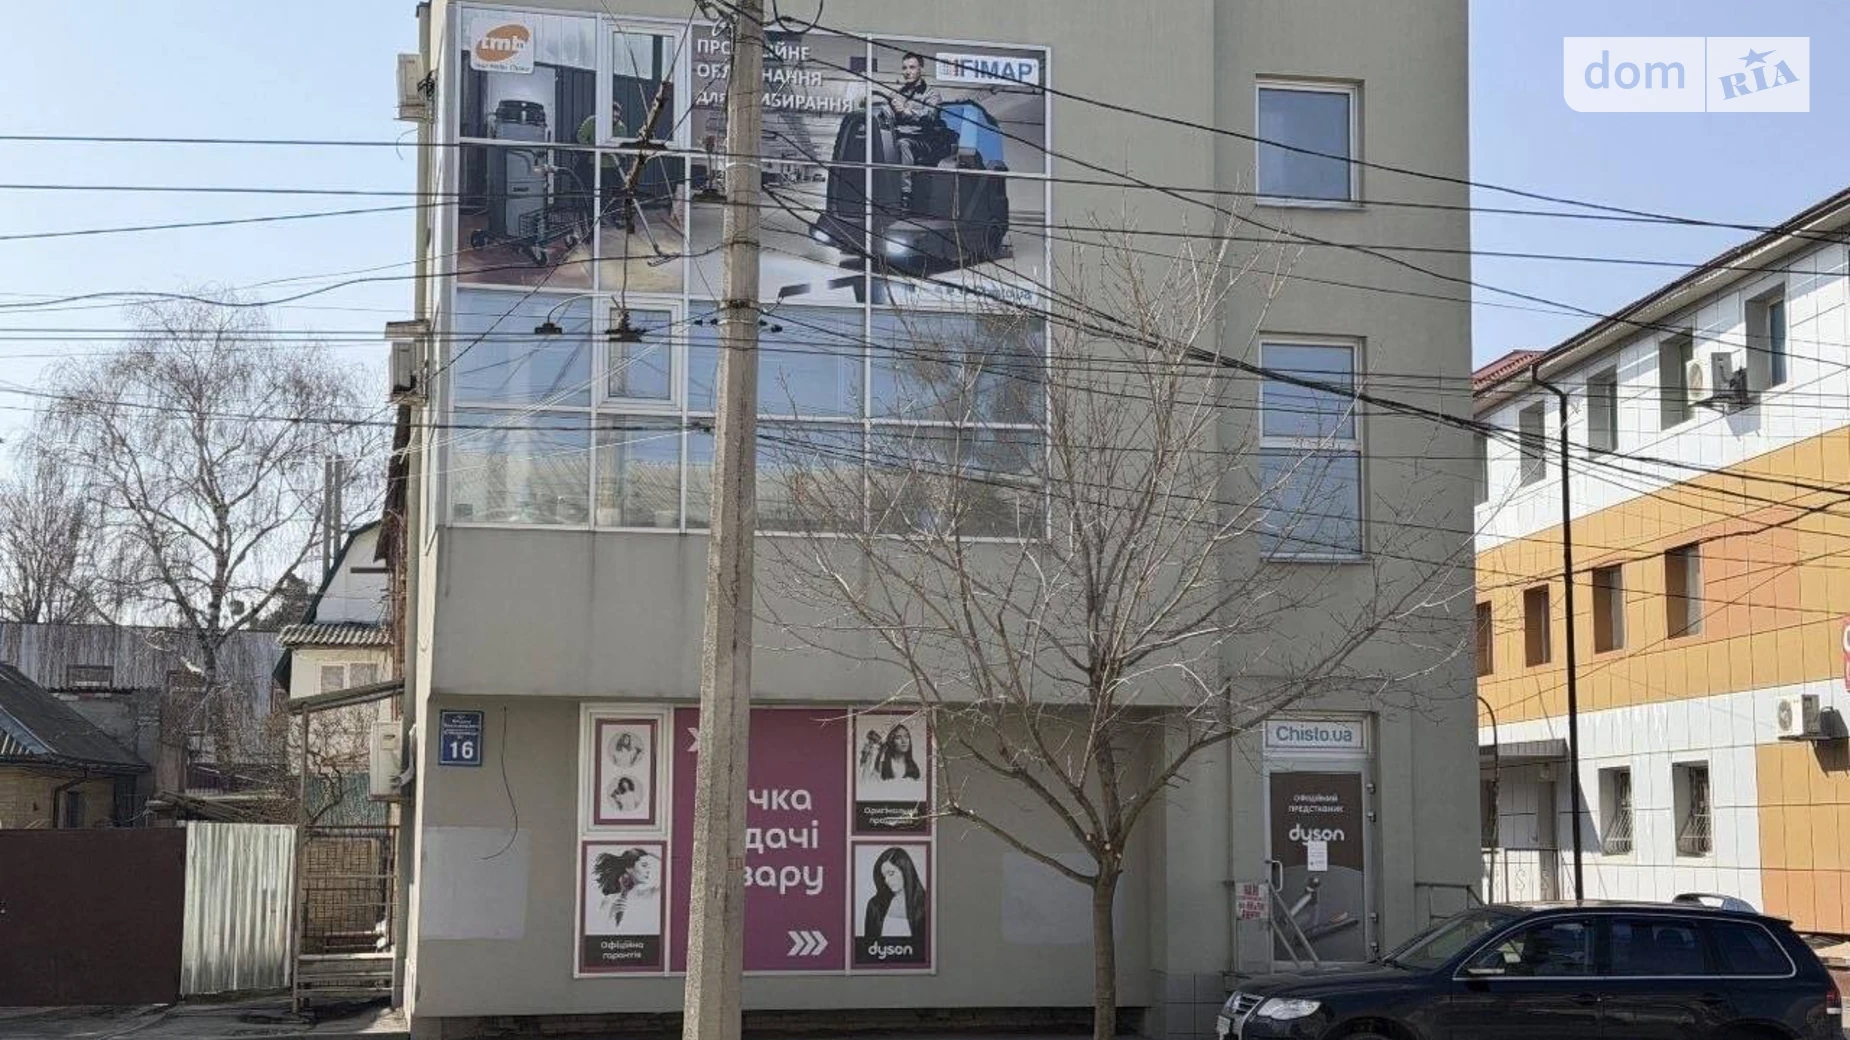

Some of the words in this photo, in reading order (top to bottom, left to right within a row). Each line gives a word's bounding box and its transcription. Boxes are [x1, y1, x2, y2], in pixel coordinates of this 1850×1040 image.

[450, 741, 474, 759] 16
[748, 789, 813, 811] чка
[745, 820, 819, 854] дачі
[1289, 823, 1345, 846] dyson
[744, 865, 824, 895] вару
[868, 941, 913, 960] dyson
